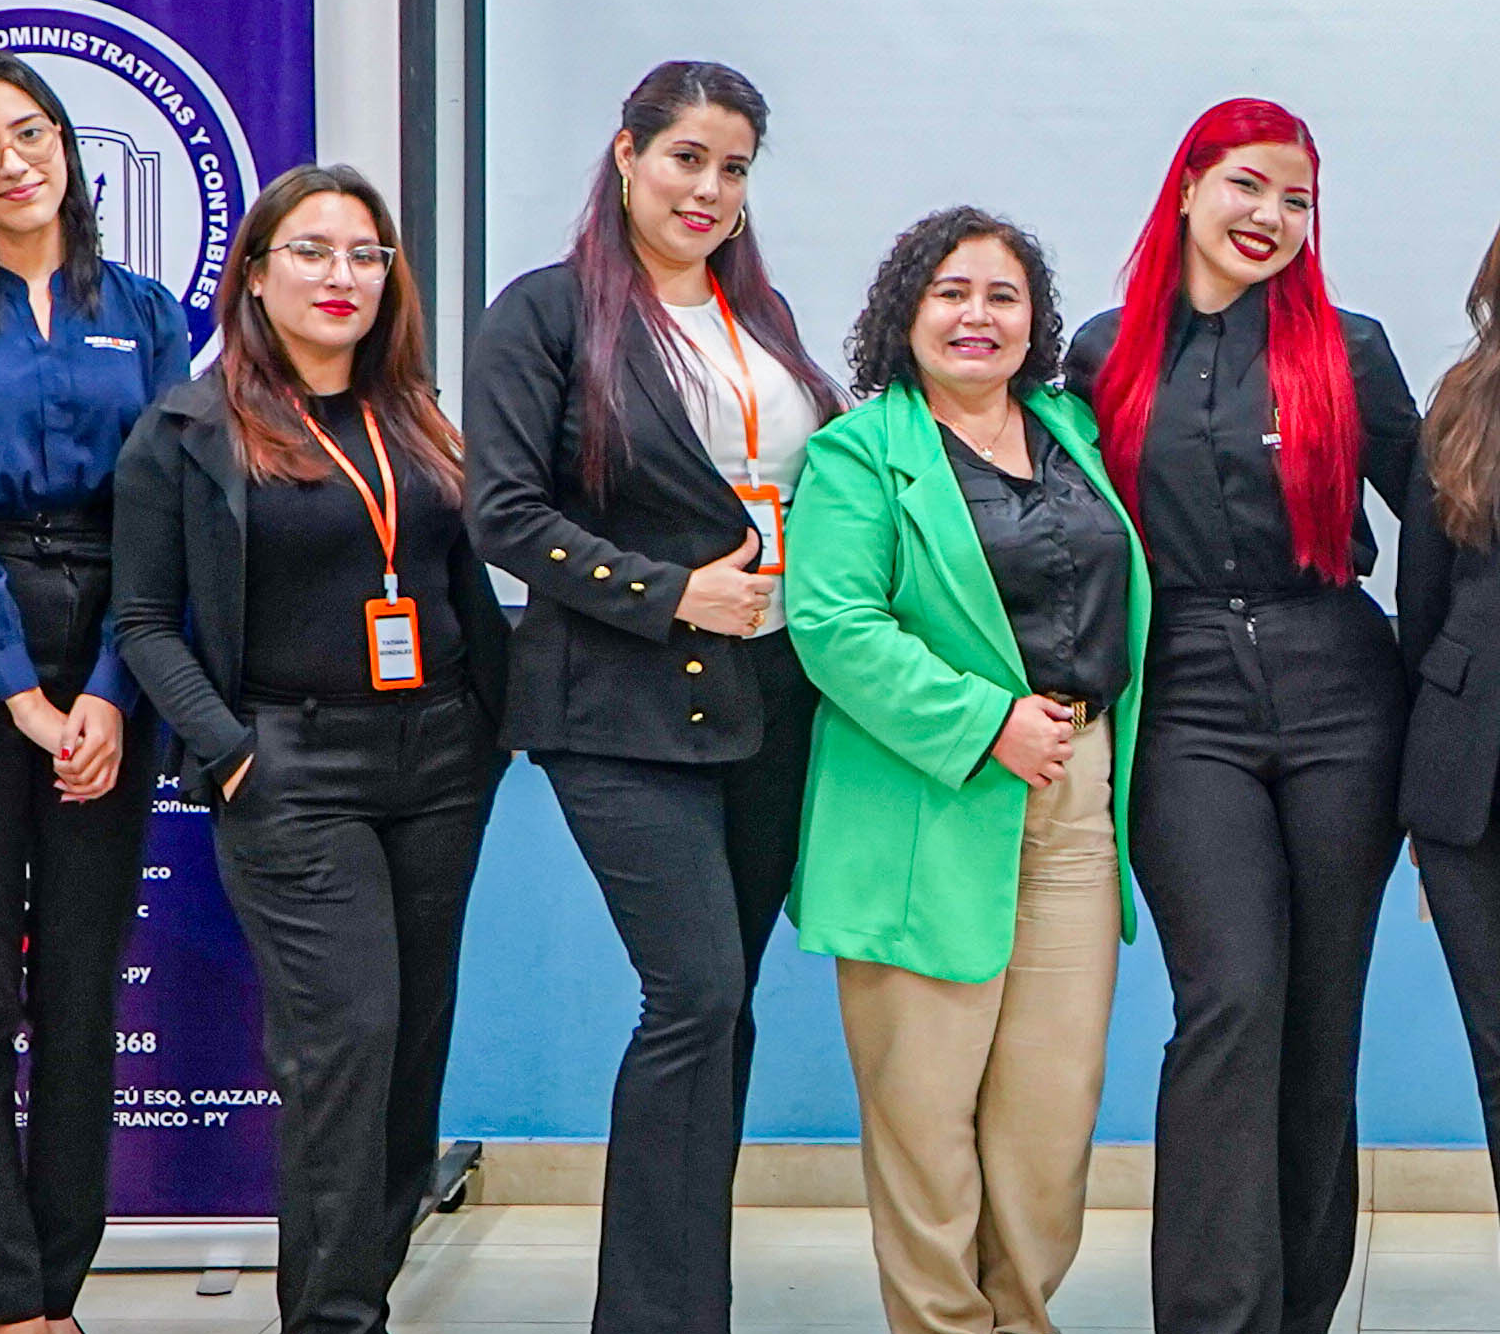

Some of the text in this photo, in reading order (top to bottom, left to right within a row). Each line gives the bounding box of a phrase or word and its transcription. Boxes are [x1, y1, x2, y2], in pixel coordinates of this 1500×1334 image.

[189, 127, 211, 146] Y
[190, 153, 228, 310] CONTABLES
[115, 1031, 157, 1053] 368
[143, 1089, 186, 1107] ESQ.
[190, 1089, 283, 1106] CAAZAPA
[204, 1111, 230, 1127] PY
